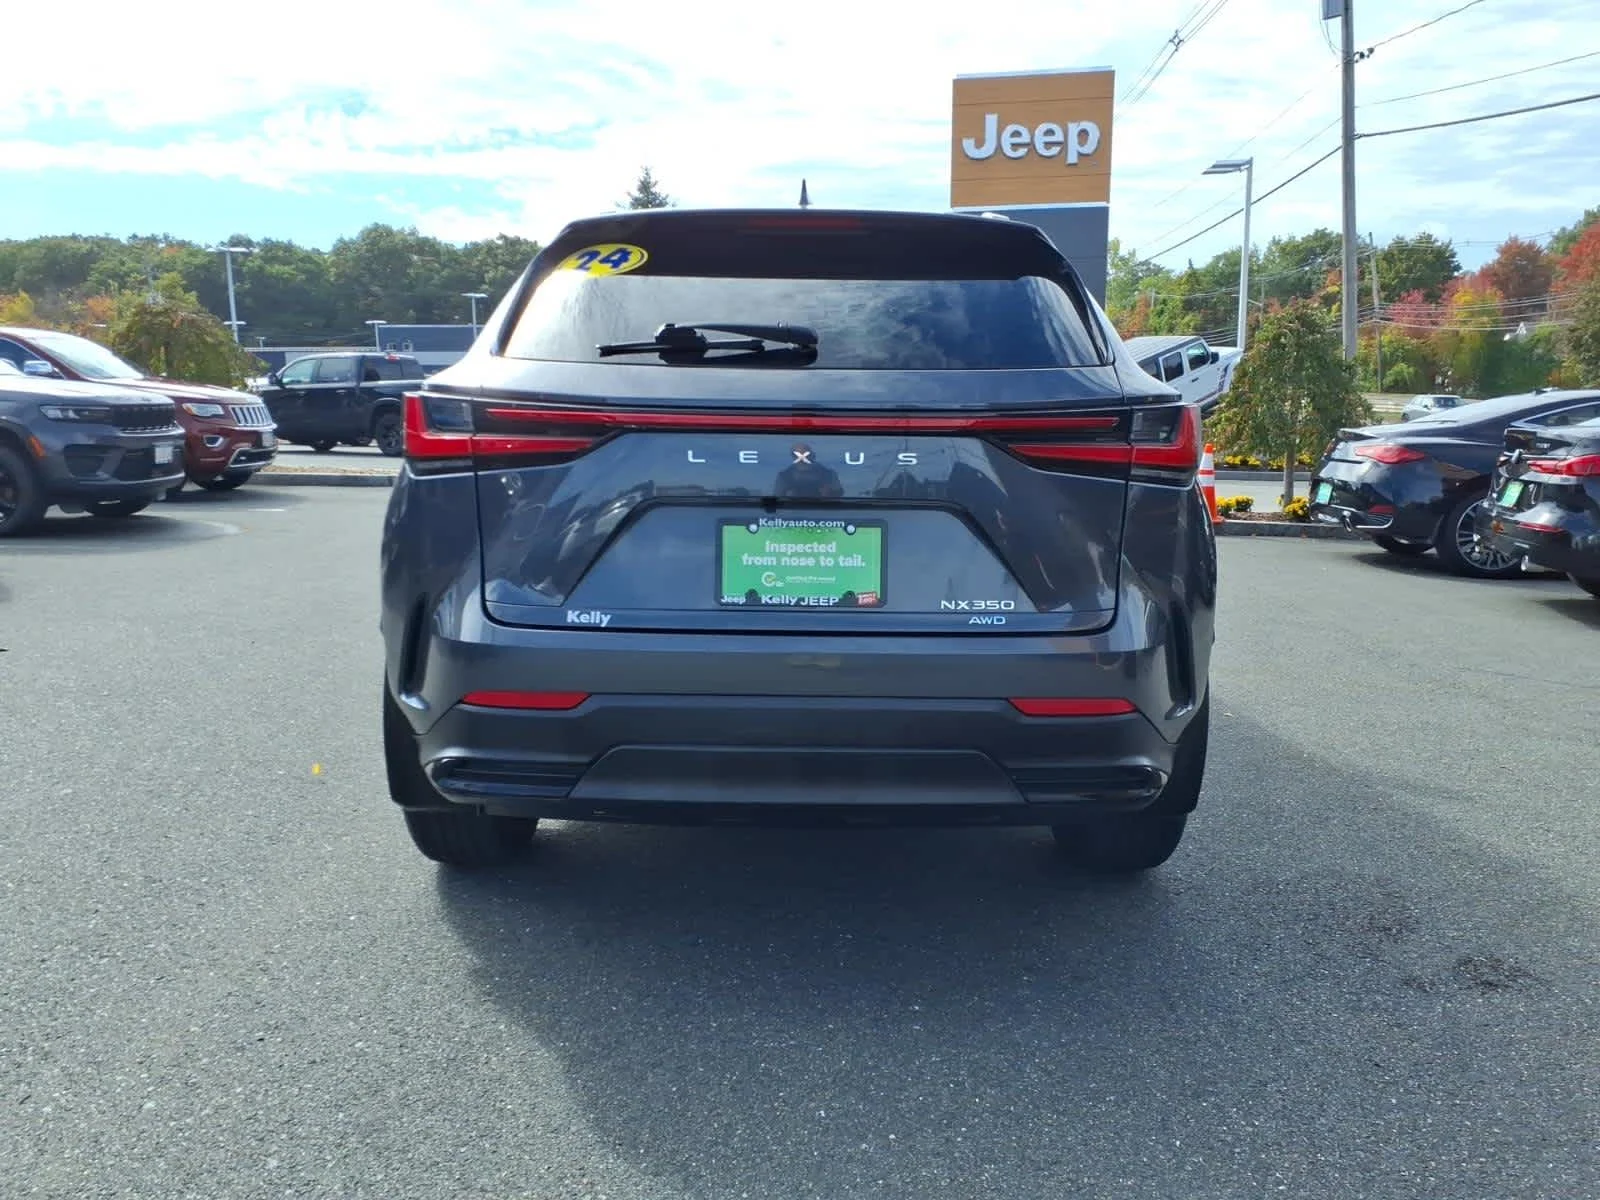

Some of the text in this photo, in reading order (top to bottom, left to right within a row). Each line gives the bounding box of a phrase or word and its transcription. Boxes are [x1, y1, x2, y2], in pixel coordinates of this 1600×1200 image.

[962, 113, 1100, 165] Jeep
[575, 247, 632, 272] 24
[687, 450, 918, 465] LEXUS
[759, 518, 845, 529] Kellyauto.com
[742, 554, 866, 567] from nose to tail.
[761, 595, 840, 606] Kelly JEEP
[567, 610, 612, 627] Kelly
[968, 616, 1006, 625] AWD
